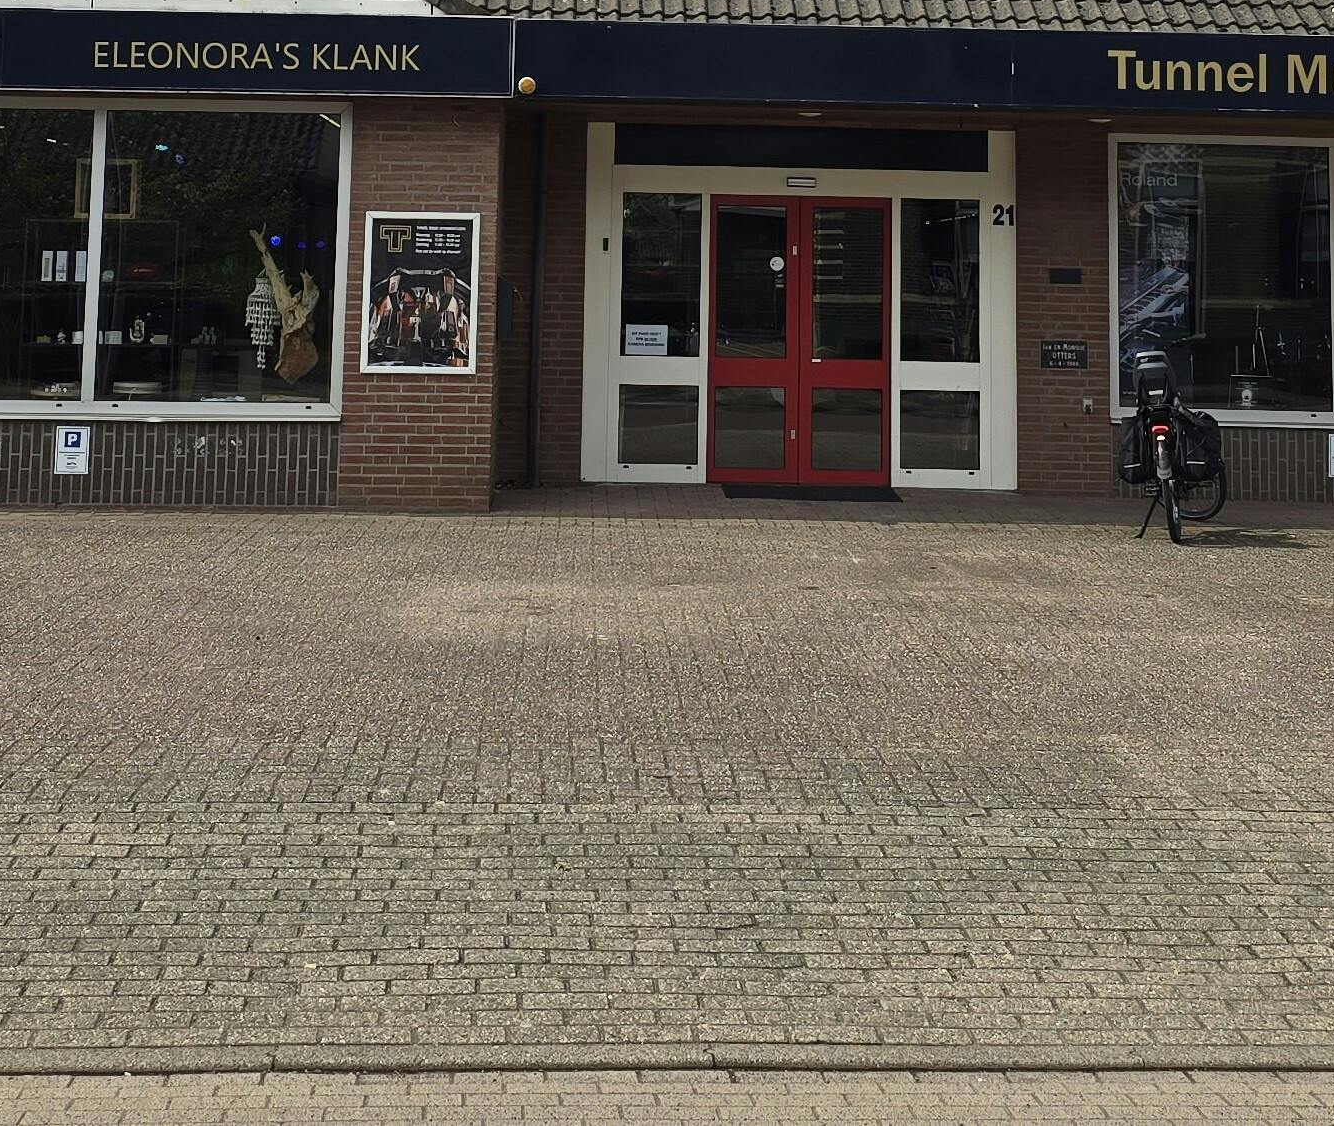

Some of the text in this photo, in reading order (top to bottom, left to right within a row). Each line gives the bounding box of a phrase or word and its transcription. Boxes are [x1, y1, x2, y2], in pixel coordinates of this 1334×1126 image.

[94, 41, 420, 71] ELEONORA'S KLANK
[1108, 50, 1267, 93] Tunnel
[1120, 170, 1178, 187] Roland
[993, 204, 1014, 226] 21
